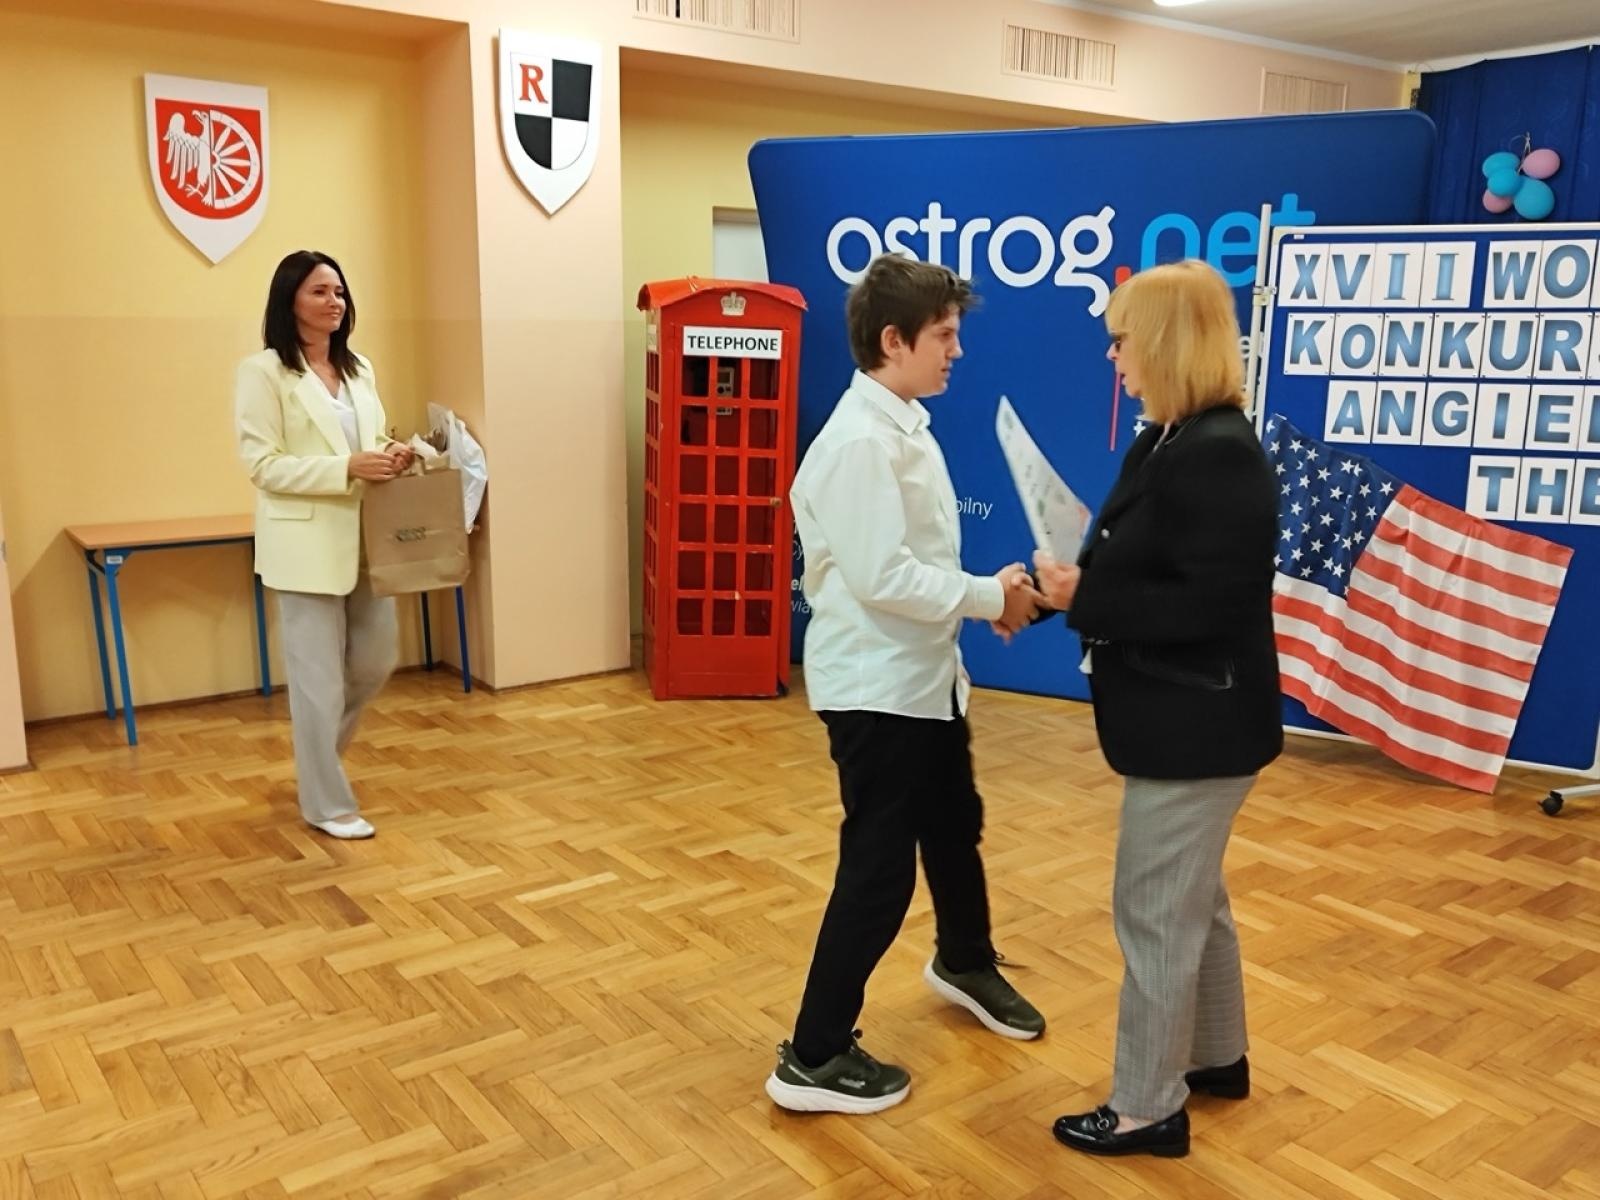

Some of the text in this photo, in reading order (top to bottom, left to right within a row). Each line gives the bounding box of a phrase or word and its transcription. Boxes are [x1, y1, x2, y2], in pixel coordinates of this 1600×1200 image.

[519, 63, 549, 104] R
[1290, 253, 1459, 301] XVII
[687, 335, 778, 351] TELEPHONE
[1289, 319, 1600, 372] KONKUR
